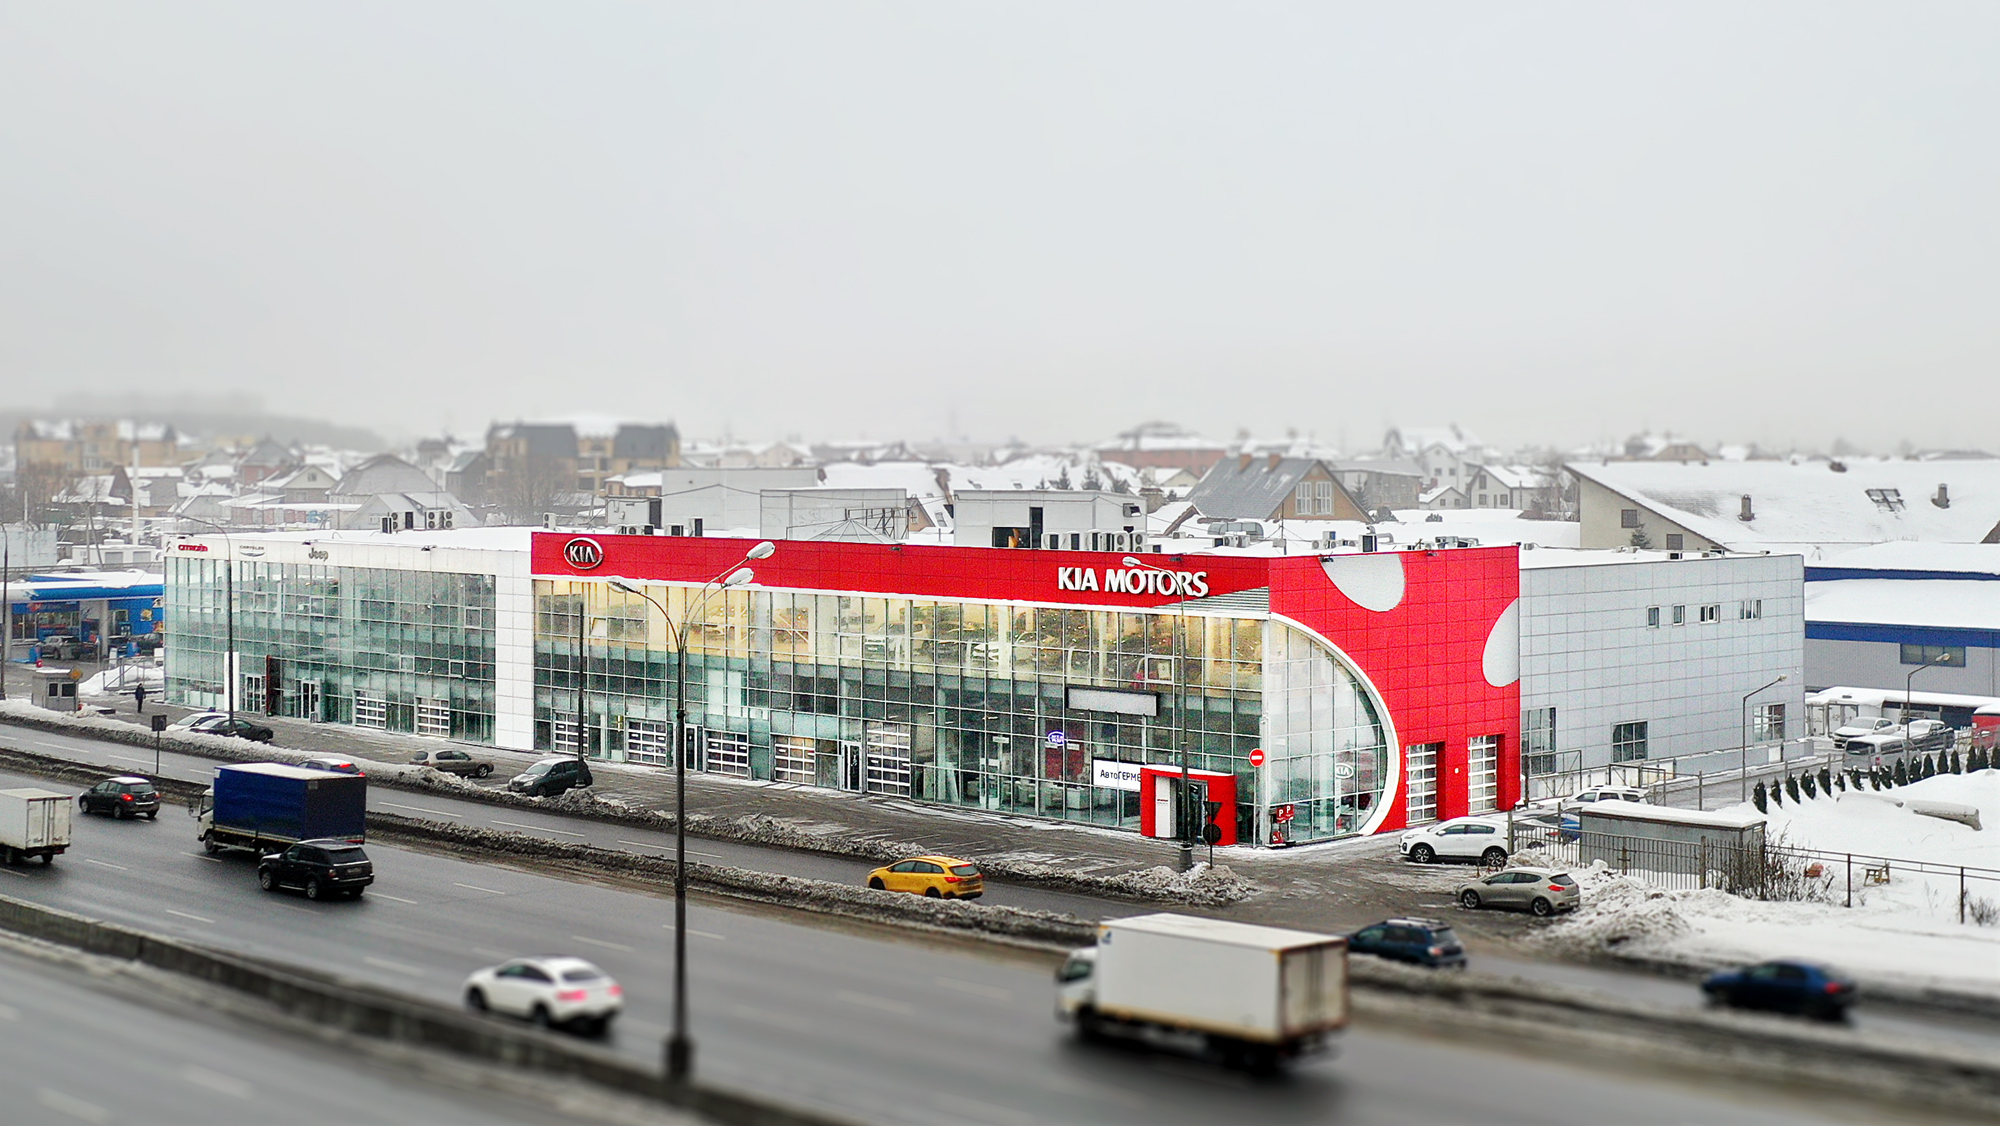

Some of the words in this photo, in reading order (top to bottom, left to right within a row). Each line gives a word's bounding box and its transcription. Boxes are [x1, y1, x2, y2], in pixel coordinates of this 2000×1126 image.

[308, 547, 329, 561] Jeep
[569, 545, 597, 562] KIA
[1058, 567, 1099, 591] KIA
[1104, 569, 1209, 597] MOTORS
